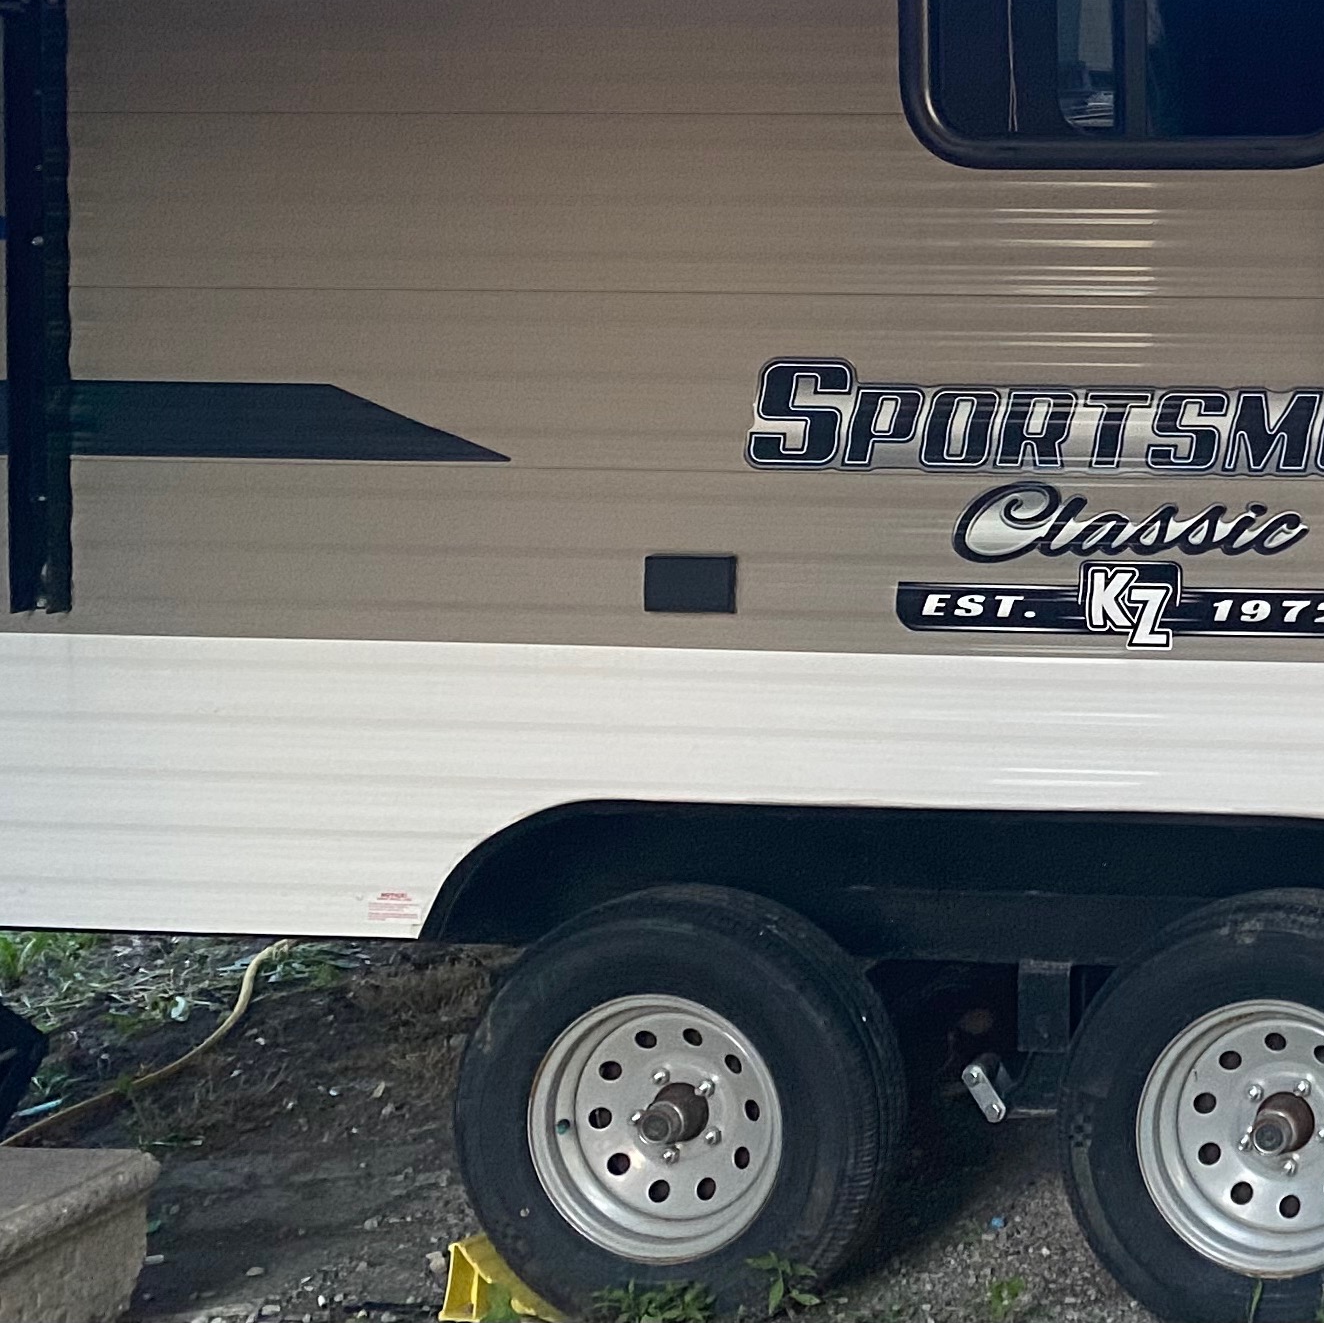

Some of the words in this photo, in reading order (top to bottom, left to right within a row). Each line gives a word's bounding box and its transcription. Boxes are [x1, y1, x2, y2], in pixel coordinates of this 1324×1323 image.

[952, 481, 1311, 564] Classic
[921, 594, 1037, 619] EST.
[1084, 567, 1173, 651] KZ
